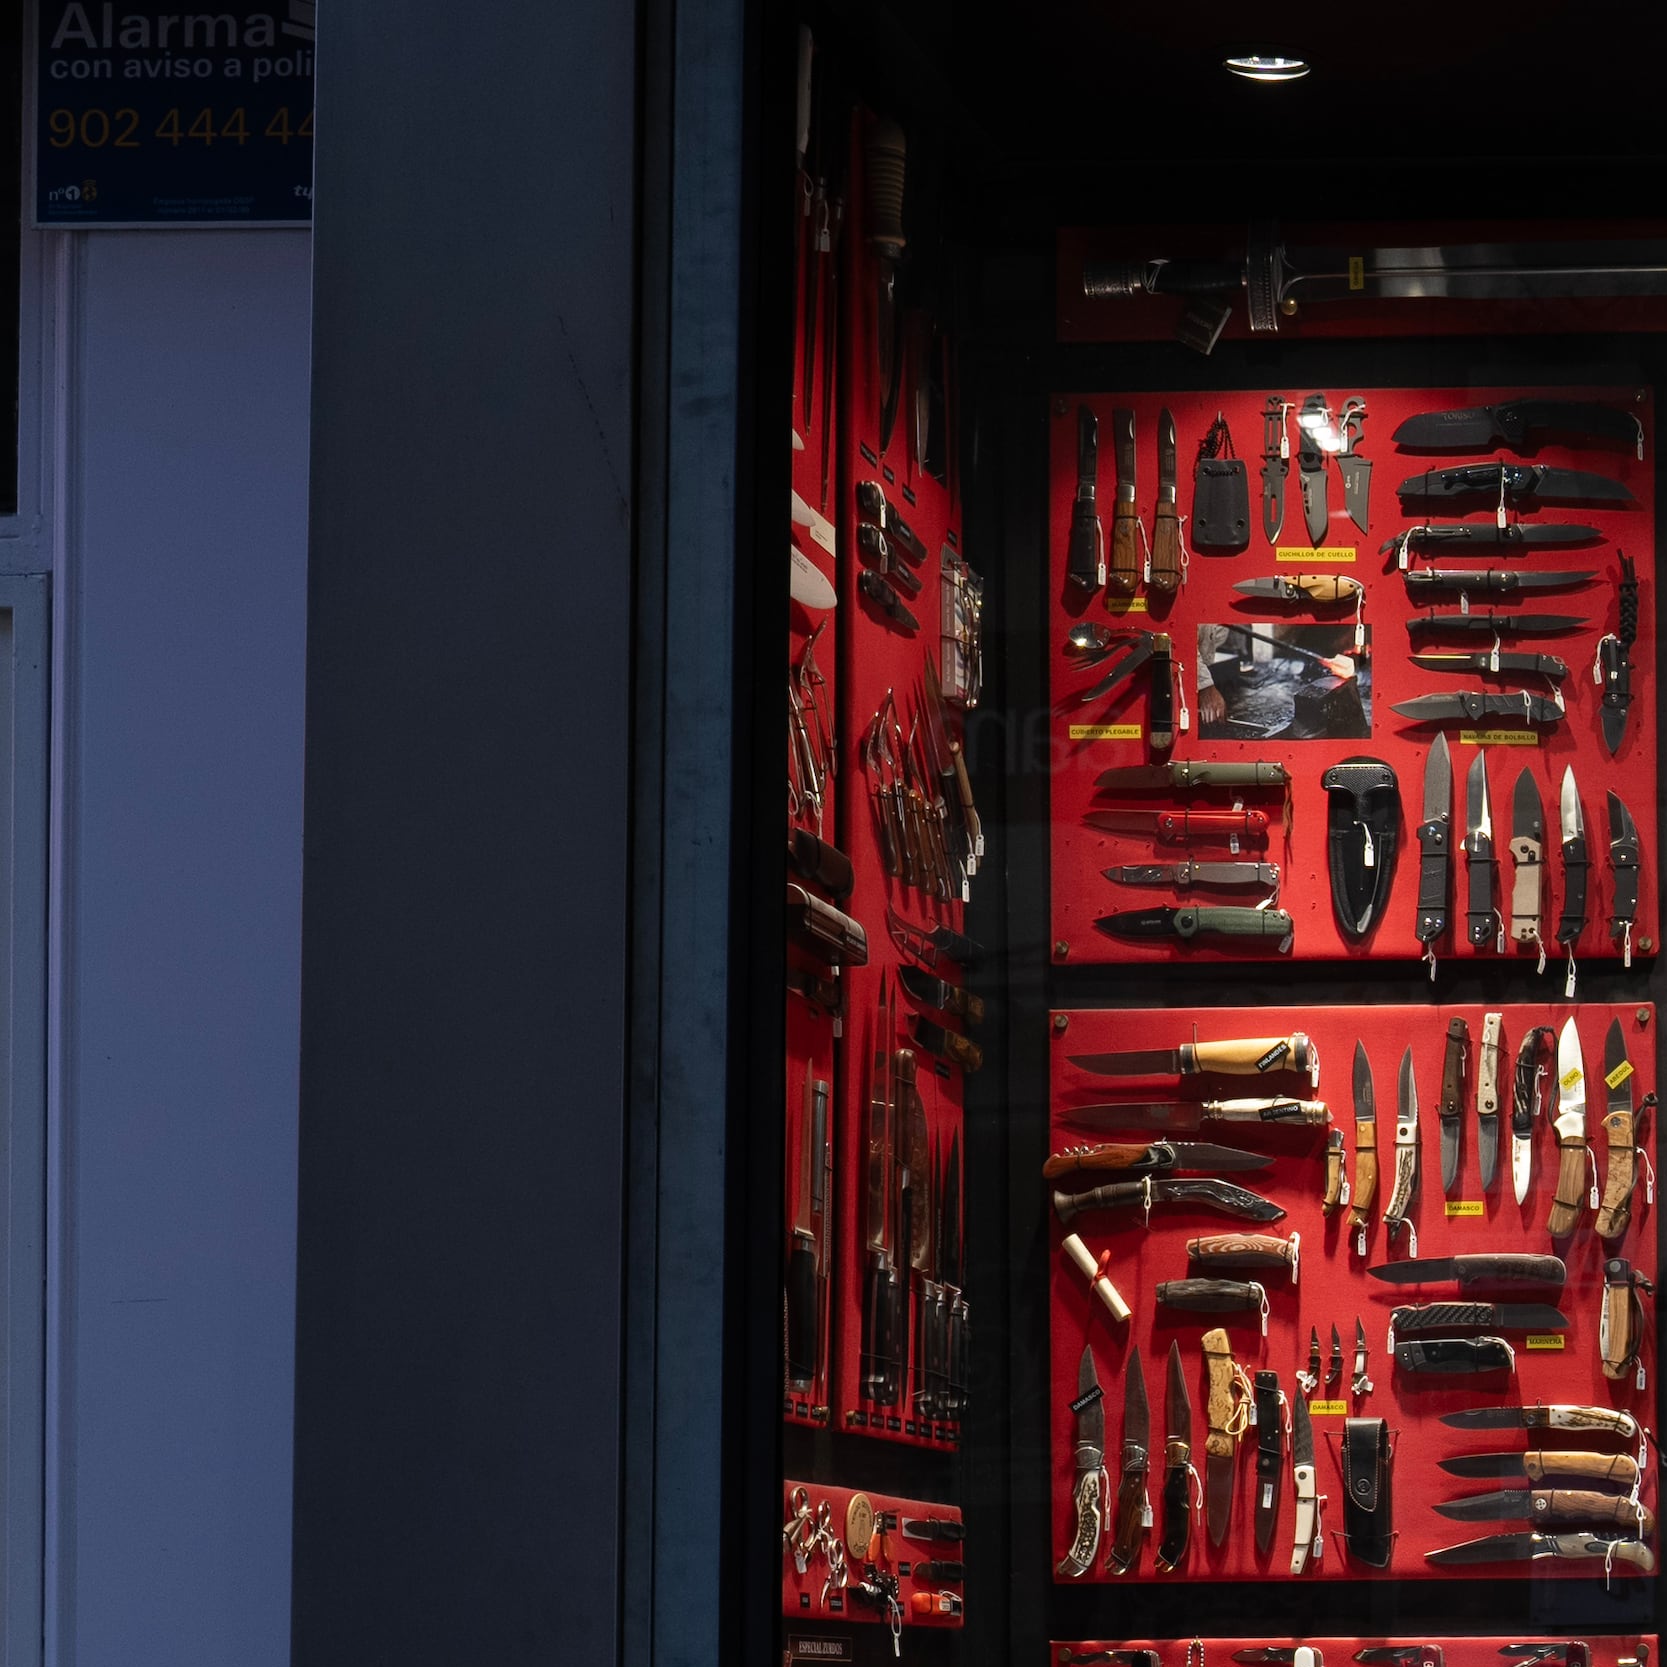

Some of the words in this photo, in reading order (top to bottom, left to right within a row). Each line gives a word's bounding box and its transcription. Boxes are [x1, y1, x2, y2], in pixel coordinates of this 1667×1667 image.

[50, 2, 276, 48] Alarma
[50, 58, 112, 79] con
[123, 52, 213, 78] aviso
[223, 57, 242, 77] a
[49, 107, 141, 148] 902
[155, 106, 250, 146] 444
[1278, 551, 1314, 559] CUCHILLOS
[1328, 551, 1354, 559] CUELLO
[1072, 1388, 1101, 1411] DAMASCO
[799, 1640, 822, 1655] ESPECIAL
